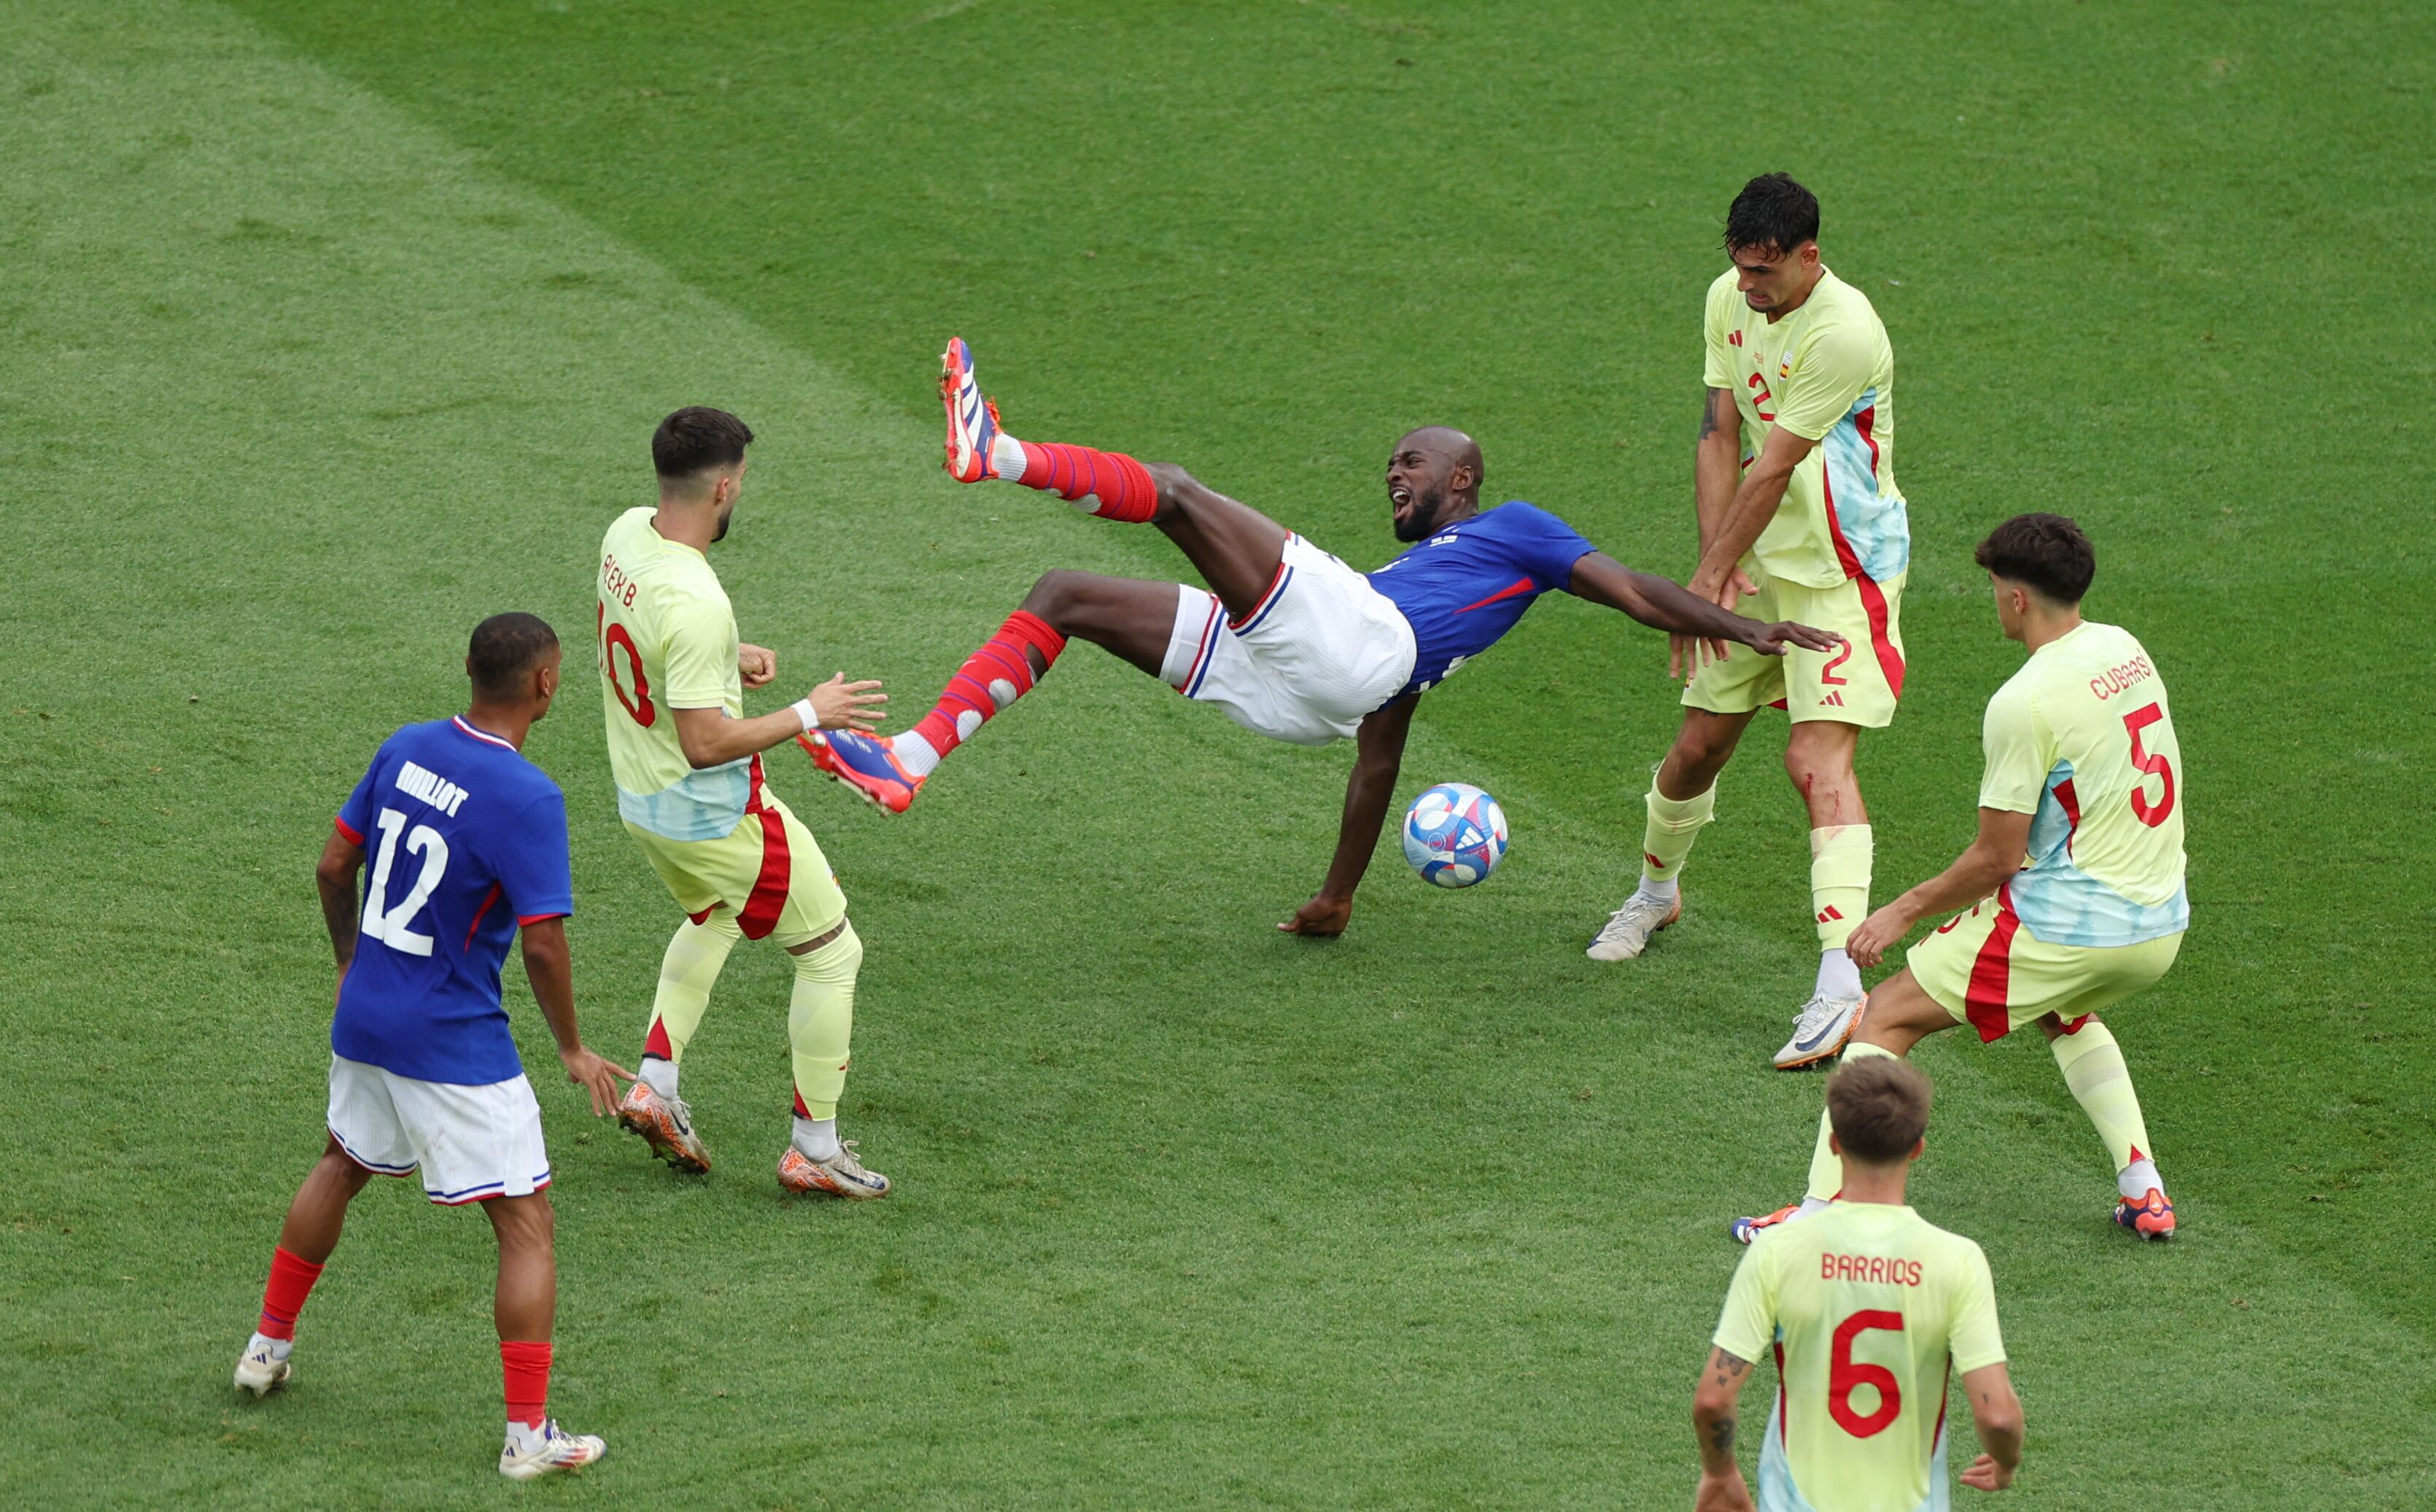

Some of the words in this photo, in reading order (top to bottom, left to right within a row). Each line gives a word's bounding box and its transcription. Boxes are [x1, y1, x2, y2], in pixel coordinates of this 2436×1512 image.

[1748, 372, 1775, 422] 2
[602, 554, 627, 599] ALEX
[623, 581, 637, 612] B.
[1821, 639, 1853, 686] 2
[2122, 702, 2176, 828] 5
[360, 807, 450, 958] 12
[1820, 1252, 1923, 1287] BARRIOS
[1828, 1308, 1904, 1439] 6
